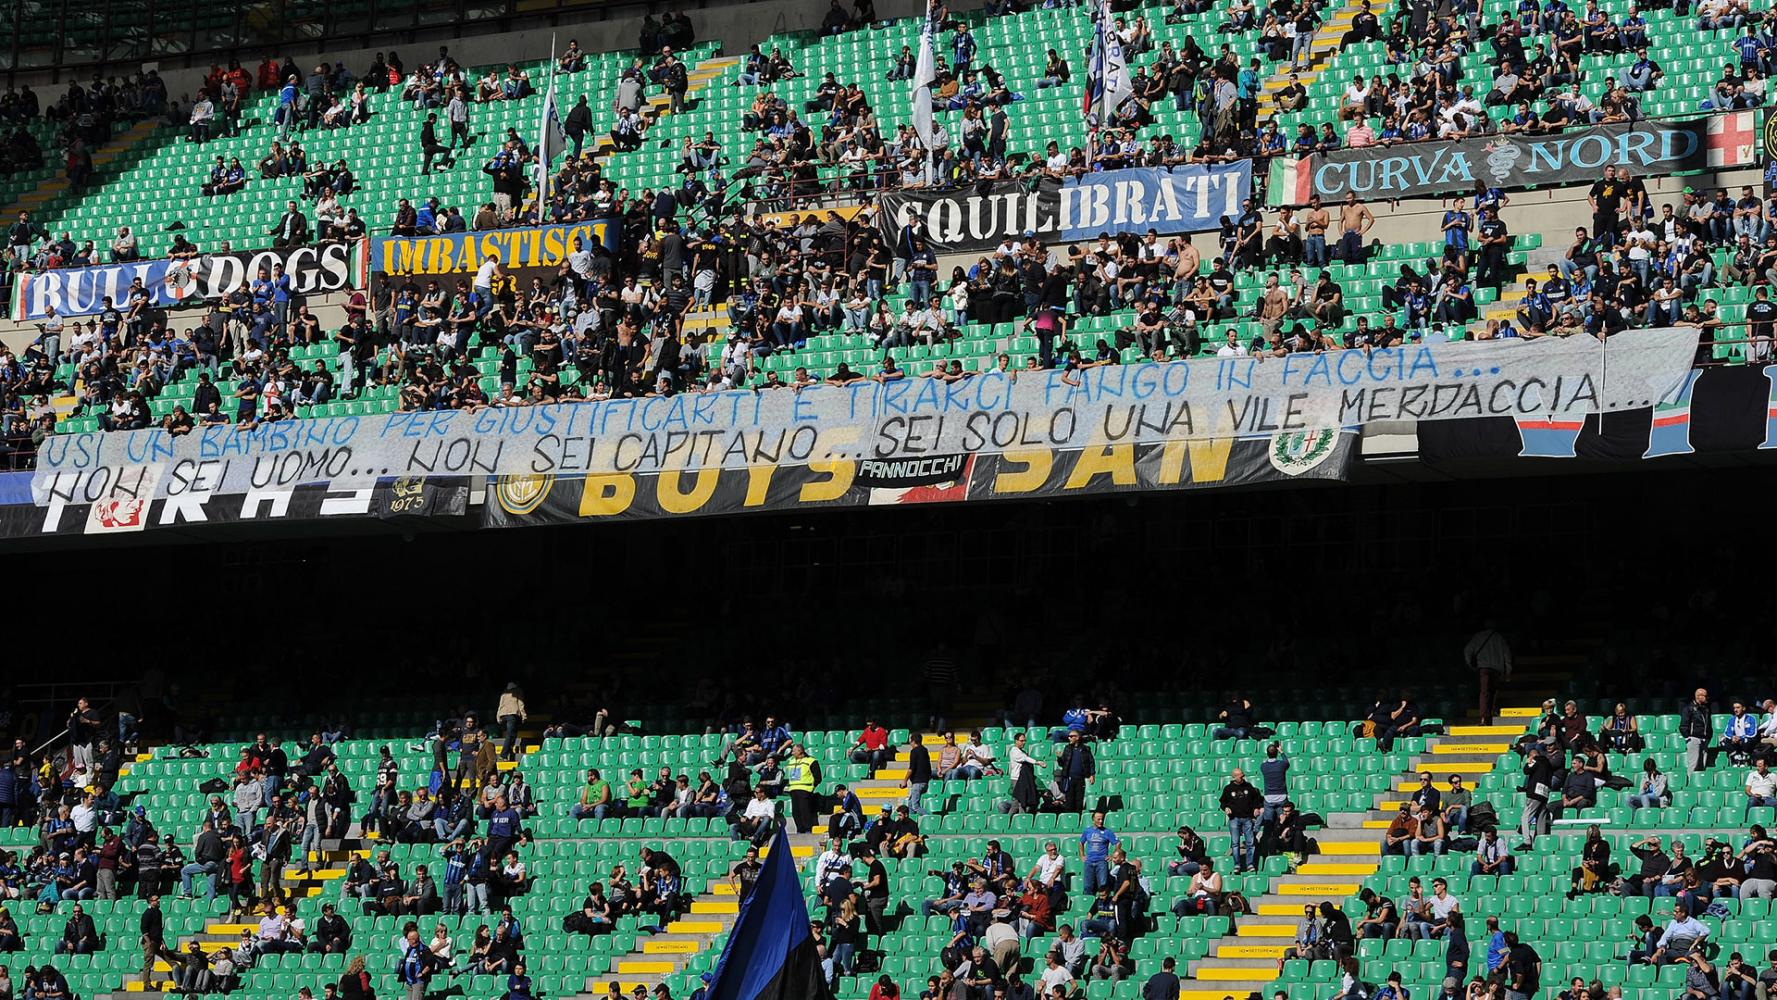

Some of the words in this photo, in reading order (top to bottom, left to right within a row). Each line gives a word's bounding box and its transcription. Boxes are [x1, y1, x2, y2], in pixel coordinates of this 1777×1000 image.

[1314, 147, 1476, 195] CURVA
[1524, 129, 1698, 173] NORD
[48, 433, 104, 468] USI
[128, 430, 176, 463] UN
[201, 414, 360, 458] BAMBINO
[381, 410, 458, 438] PER
[476, 392, 763, 436] GIUSTIFICARTI
[794, 386, 818, 424] E
[848, 372, 1012, 418] TIRARCI
[1046, 360, 1190, 405] FANGO
[1217, 359, 1256, 391] IN
[47, 466, 147, 503] NON
[167, 458, 231, 497] SEI
[407, 437, 503, 474] NON
[532, 434, 595, 473] SEI
[875, 416, 944, 458] SEI
[962, 408, 1077, 451] SOLO
[1104, 400, 1195, 440] UNA
[1227, 392, 1309, 431] VILE
[859, 455, 963, 479] PANNOCCHI
[390, 496, 424, 512] 1975
